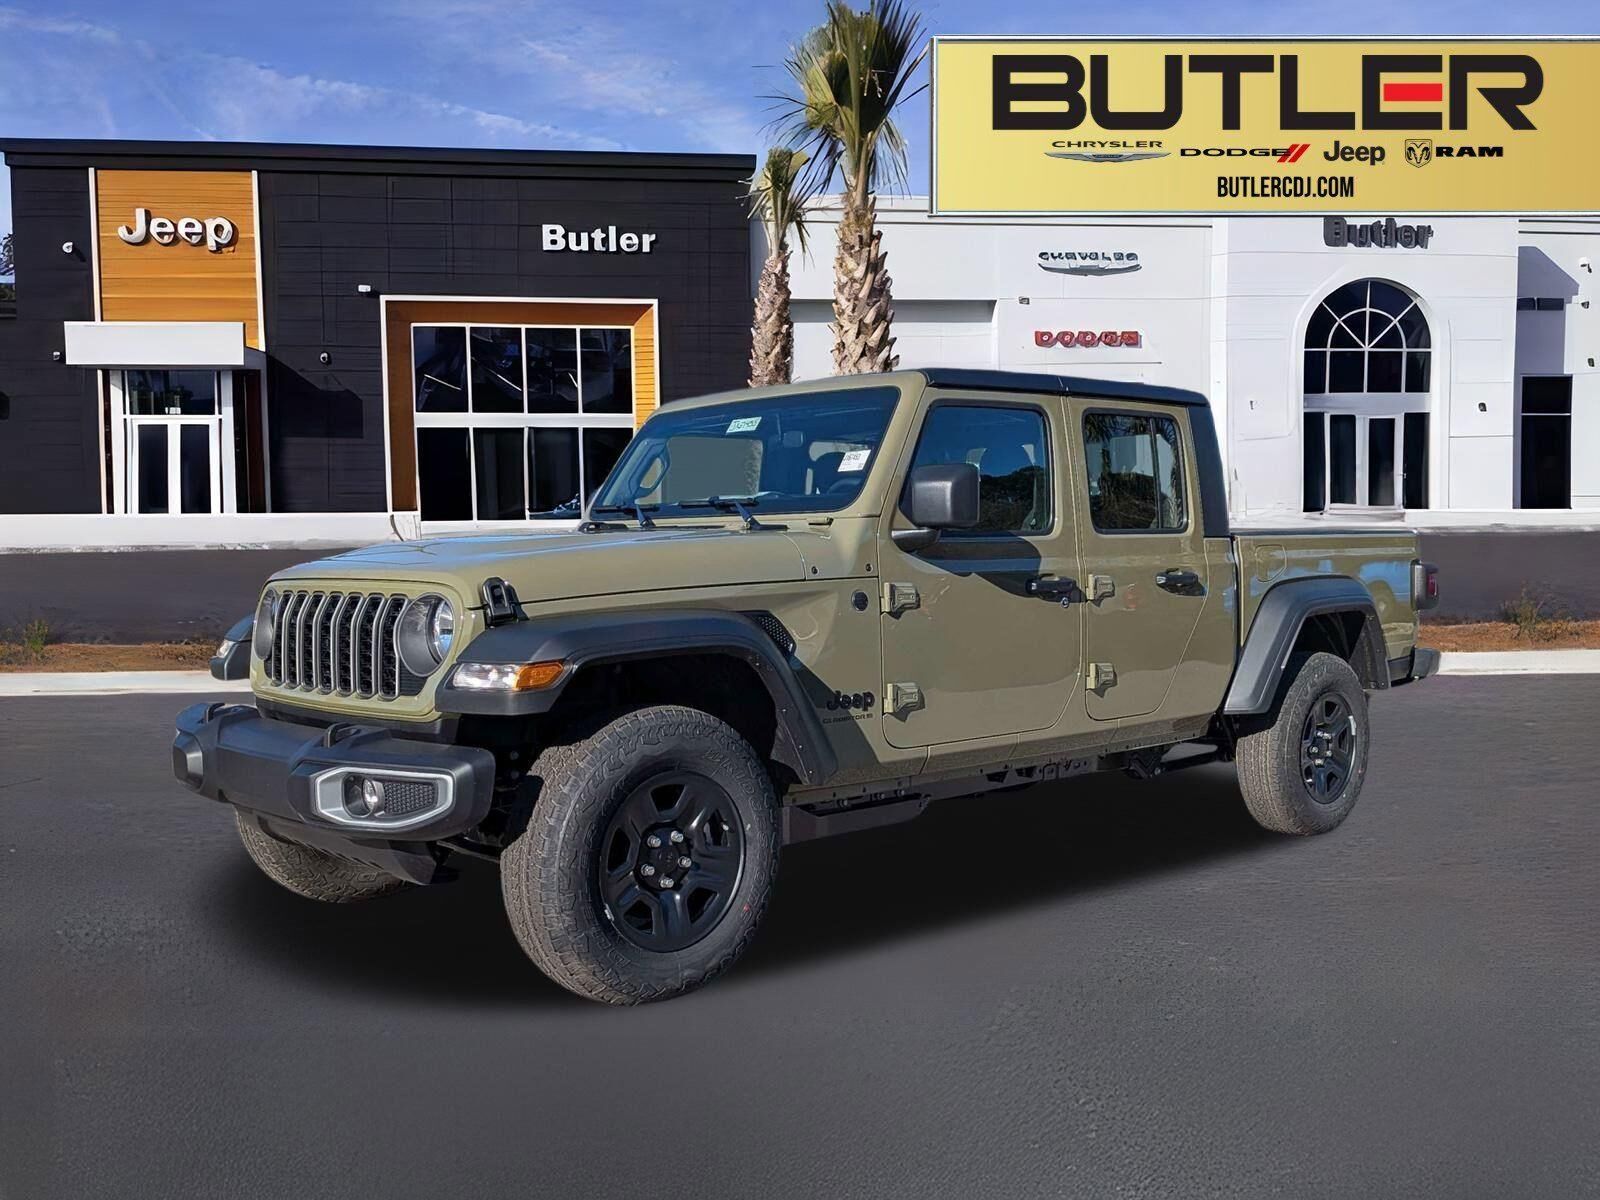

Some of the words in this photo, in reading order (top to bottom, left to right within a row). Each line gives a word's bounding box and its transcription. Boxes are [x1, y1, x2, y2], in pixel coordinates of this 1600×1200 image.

[117, 207, 234, 252] Jeep
[541, 223, 657, 253] Butler
[1323, 216, 1434, 249] Butler
[826, 690, 875, 711] Jeep
